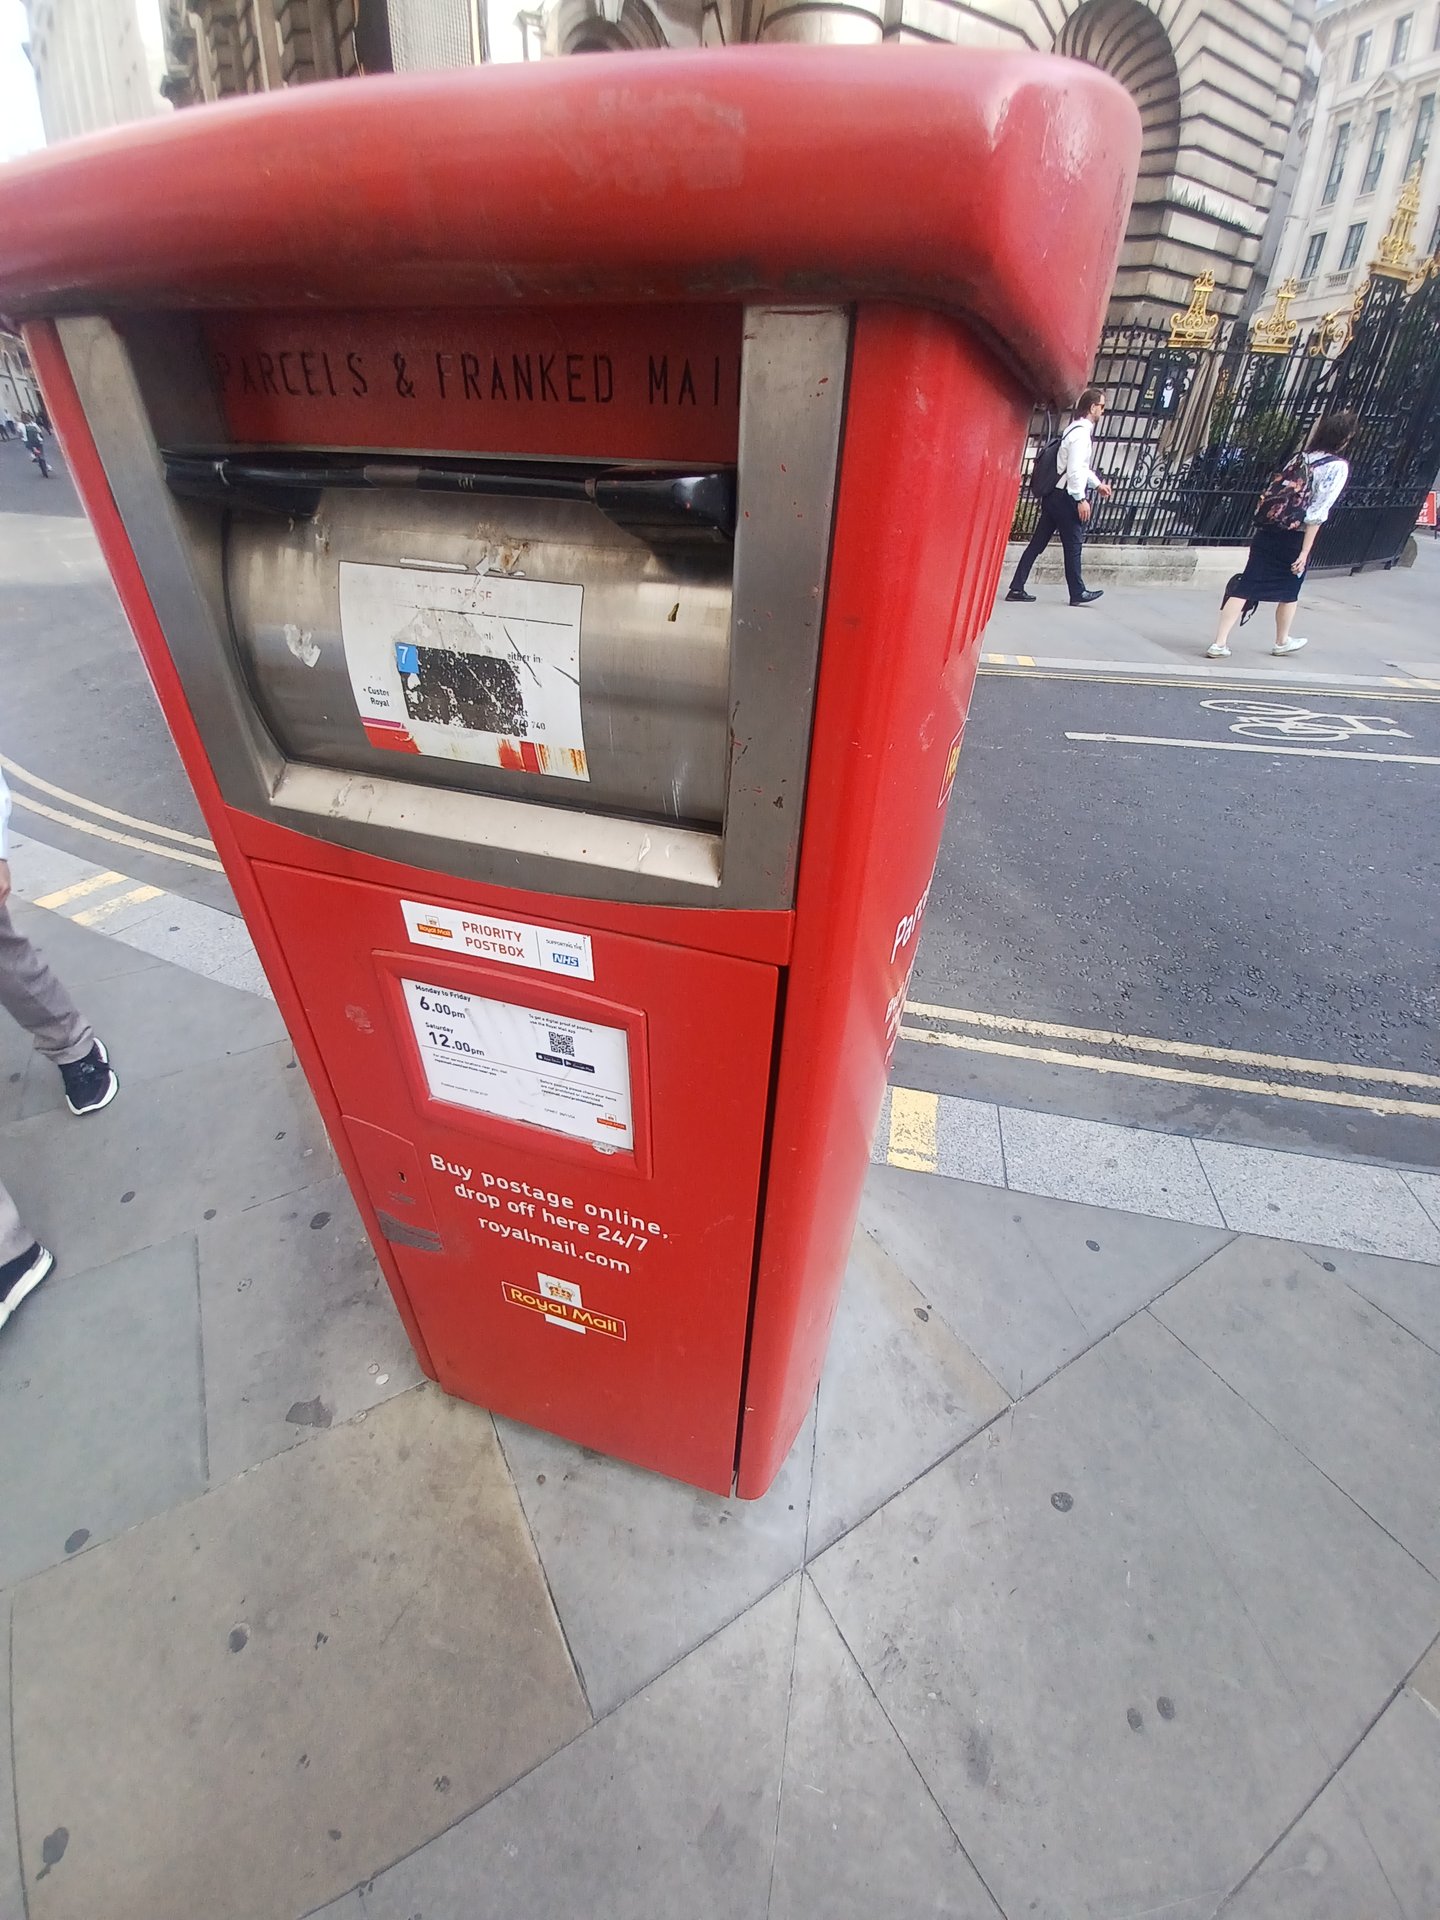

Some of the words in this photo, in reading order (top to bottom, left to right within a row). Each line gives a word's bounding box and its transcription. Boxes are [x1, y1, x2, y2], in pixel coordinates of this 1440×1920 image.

[214, 351, 369, 397] PARCELS
[393, 351, 416, 398] &
[435, 352, 614, 403] FRANKED
[649, 354, 741, 406] MAI
[398, 645, 409, 664] 7
[370, 697, 390, 708] Royal
[462, 921, 522, 943] PRIORITY
[465, 936, 525, 958] POSTBOX
[546, 939, 573, 949] SUPPORTING
[553, 953, 579, 967] NHS
[415, 984, 441, 996] Monday
[449, 991, 471, 1003] Friday
[420, 996, 466, 1019] 6.00pm
[425, 1022, 454, 1034] Saturday
[429, 1032, 485, 1057] 12.00pm
[430, 1153, 472, 1181] Buy
[481, 1171, 573, 1209] postage
[584, 1202, 669, 1239] online,
[454, 1183, 500, 1209] drop
[507, 1200, 536, 1218] off
[542, 1208, 590, 1235] here
[597, 1225, 649, 1252] 24/7
[478, 1216, 631, 1274] royalmail.com
[510, 1287, 567, 1316] Royal
[572, 1308, 617, 1333] Mail
